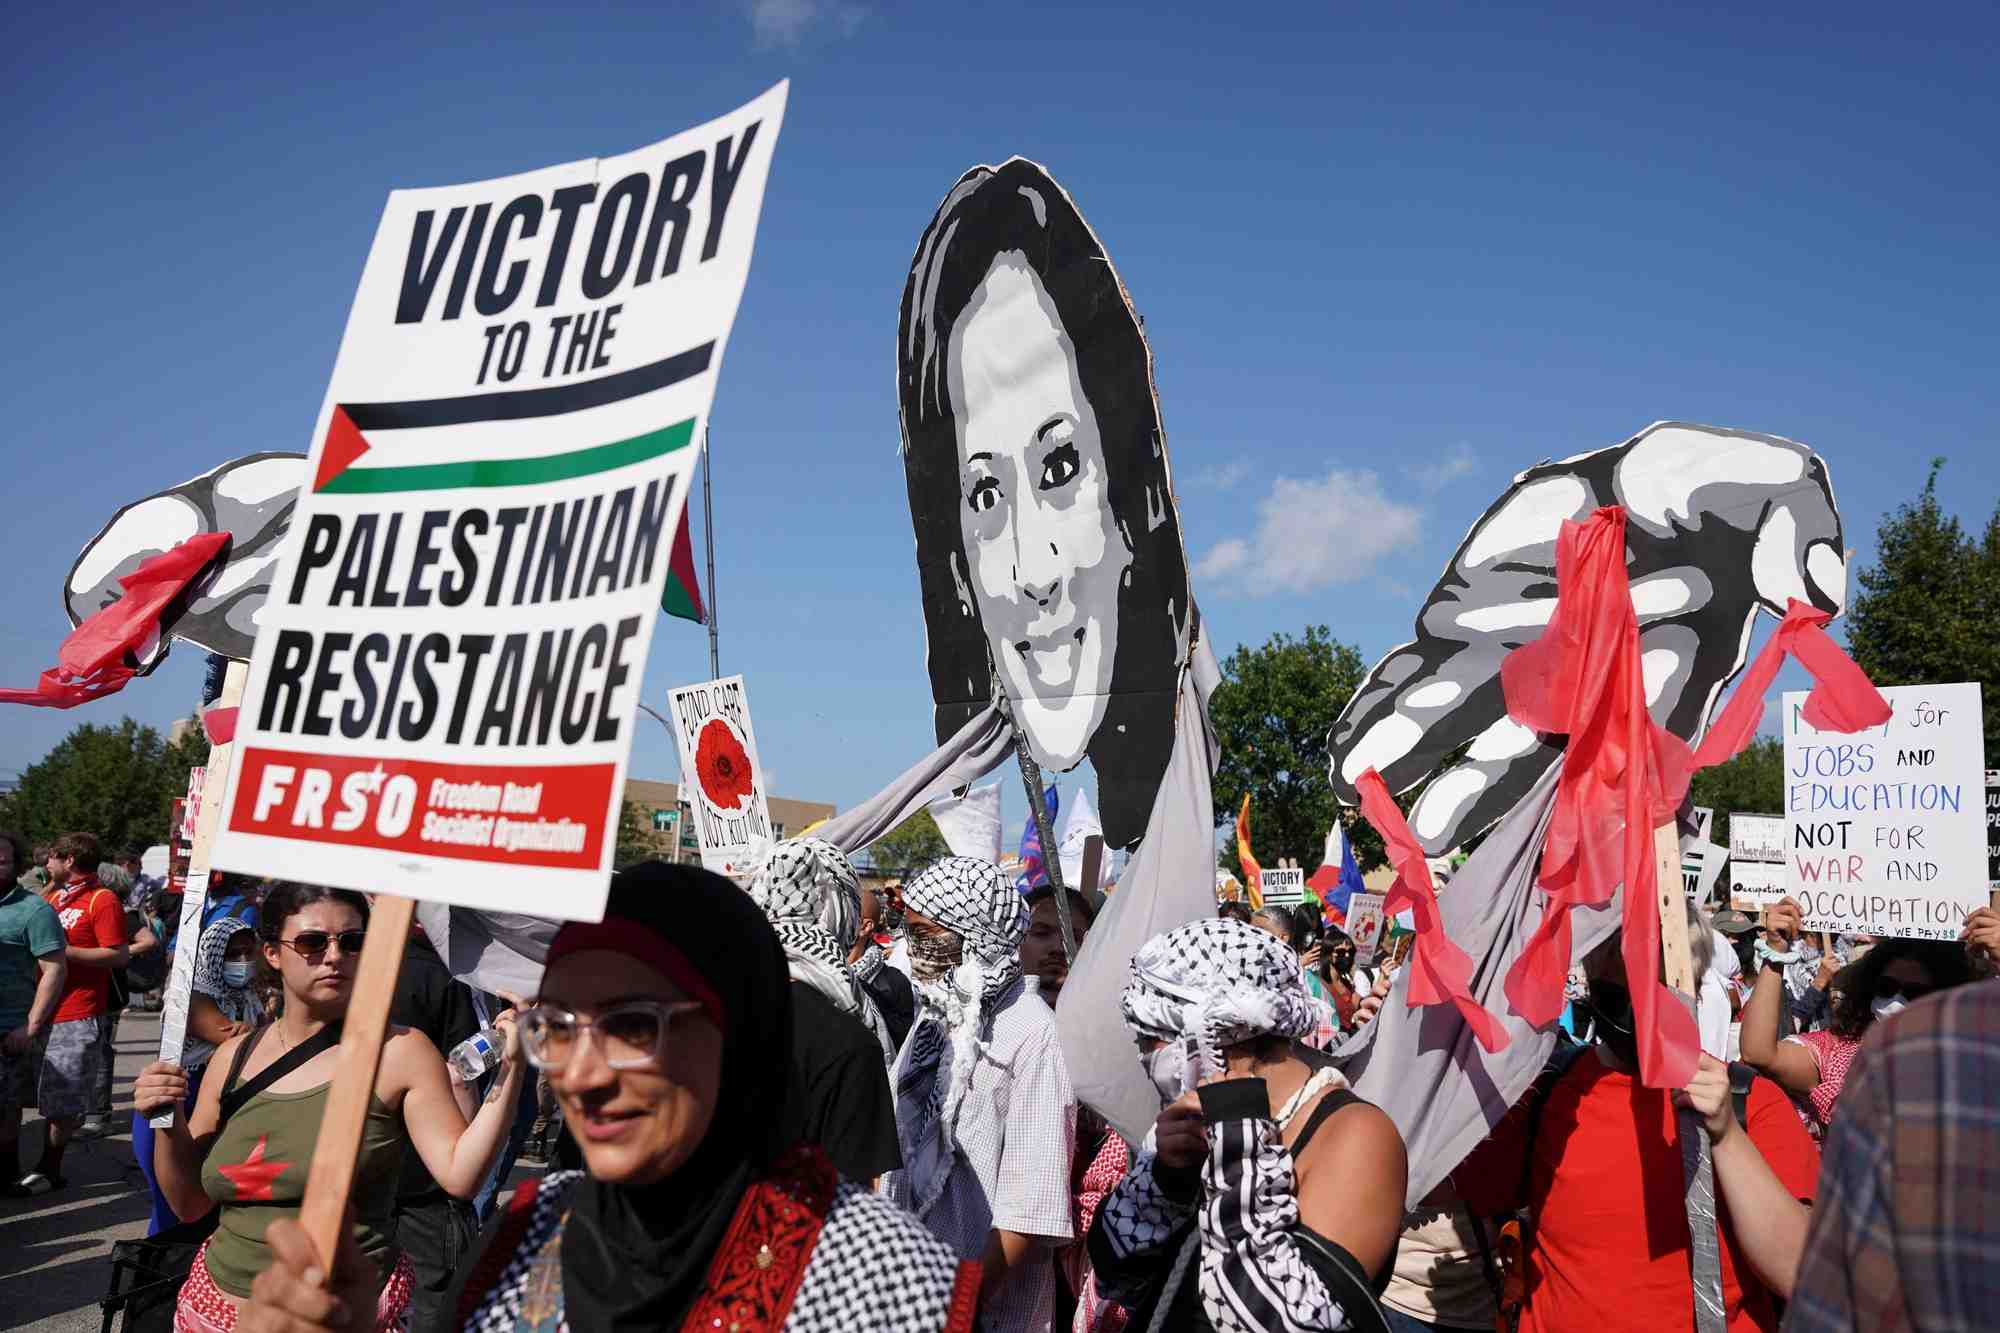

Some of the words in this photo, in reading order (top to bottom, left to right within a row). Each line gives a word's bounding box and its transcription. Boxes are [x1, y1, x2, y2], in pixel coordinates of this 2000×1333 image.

[395, 119, 762, 324] VICTORY
[475, 320, 530, 385] TO
[542, 303, 623, 378] THE
[288, 474, 678, 608] PALESTINIAN
[256, 614, 643, 746] RESISTANCE
[676, 690, 711, 752] FUND
[714, 683, 748, 744] CARE
[1910, 701, 1950, 728] for
[1792, 743, 1874, 777] JOBS
[1896, 749, 1935, 766] AND
[253, 762, 417, 838] FRSO
[1790, 782, 1960, 813] EDUCATION
[1795, 821, 1852, 849] NOT
[1875, 825, 1925, 849] FOR
[1262, 871, 1300, 886] VICTORY
[1795, 855, 1864, 882] WAR
[1887, 860, 1938, 881] AND
[1798, 890, 1970, 923] OCCUPATION
[1895, 927, 1912, 937] WE
